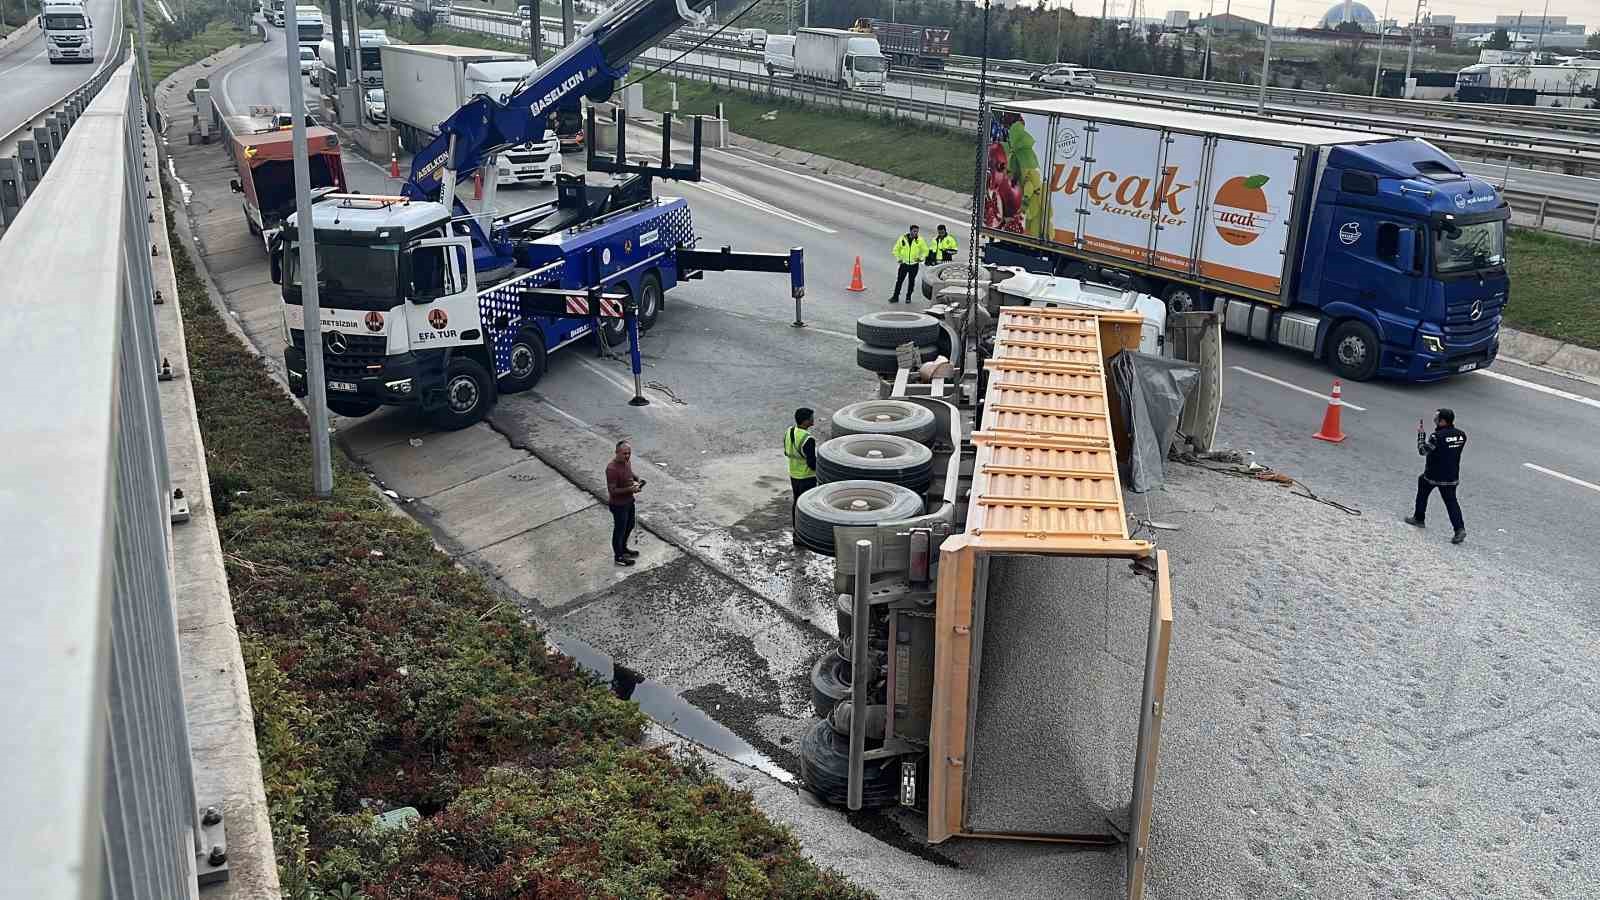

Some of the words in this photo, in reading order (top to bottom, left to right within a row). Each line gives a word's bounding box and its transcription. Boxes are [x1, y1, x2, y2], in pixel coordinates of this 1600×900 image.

[530, 71, 585, 117] BASELKON
[1049, 163, 1191, 215] uçak
[437, 330, 457, 338] TUR
